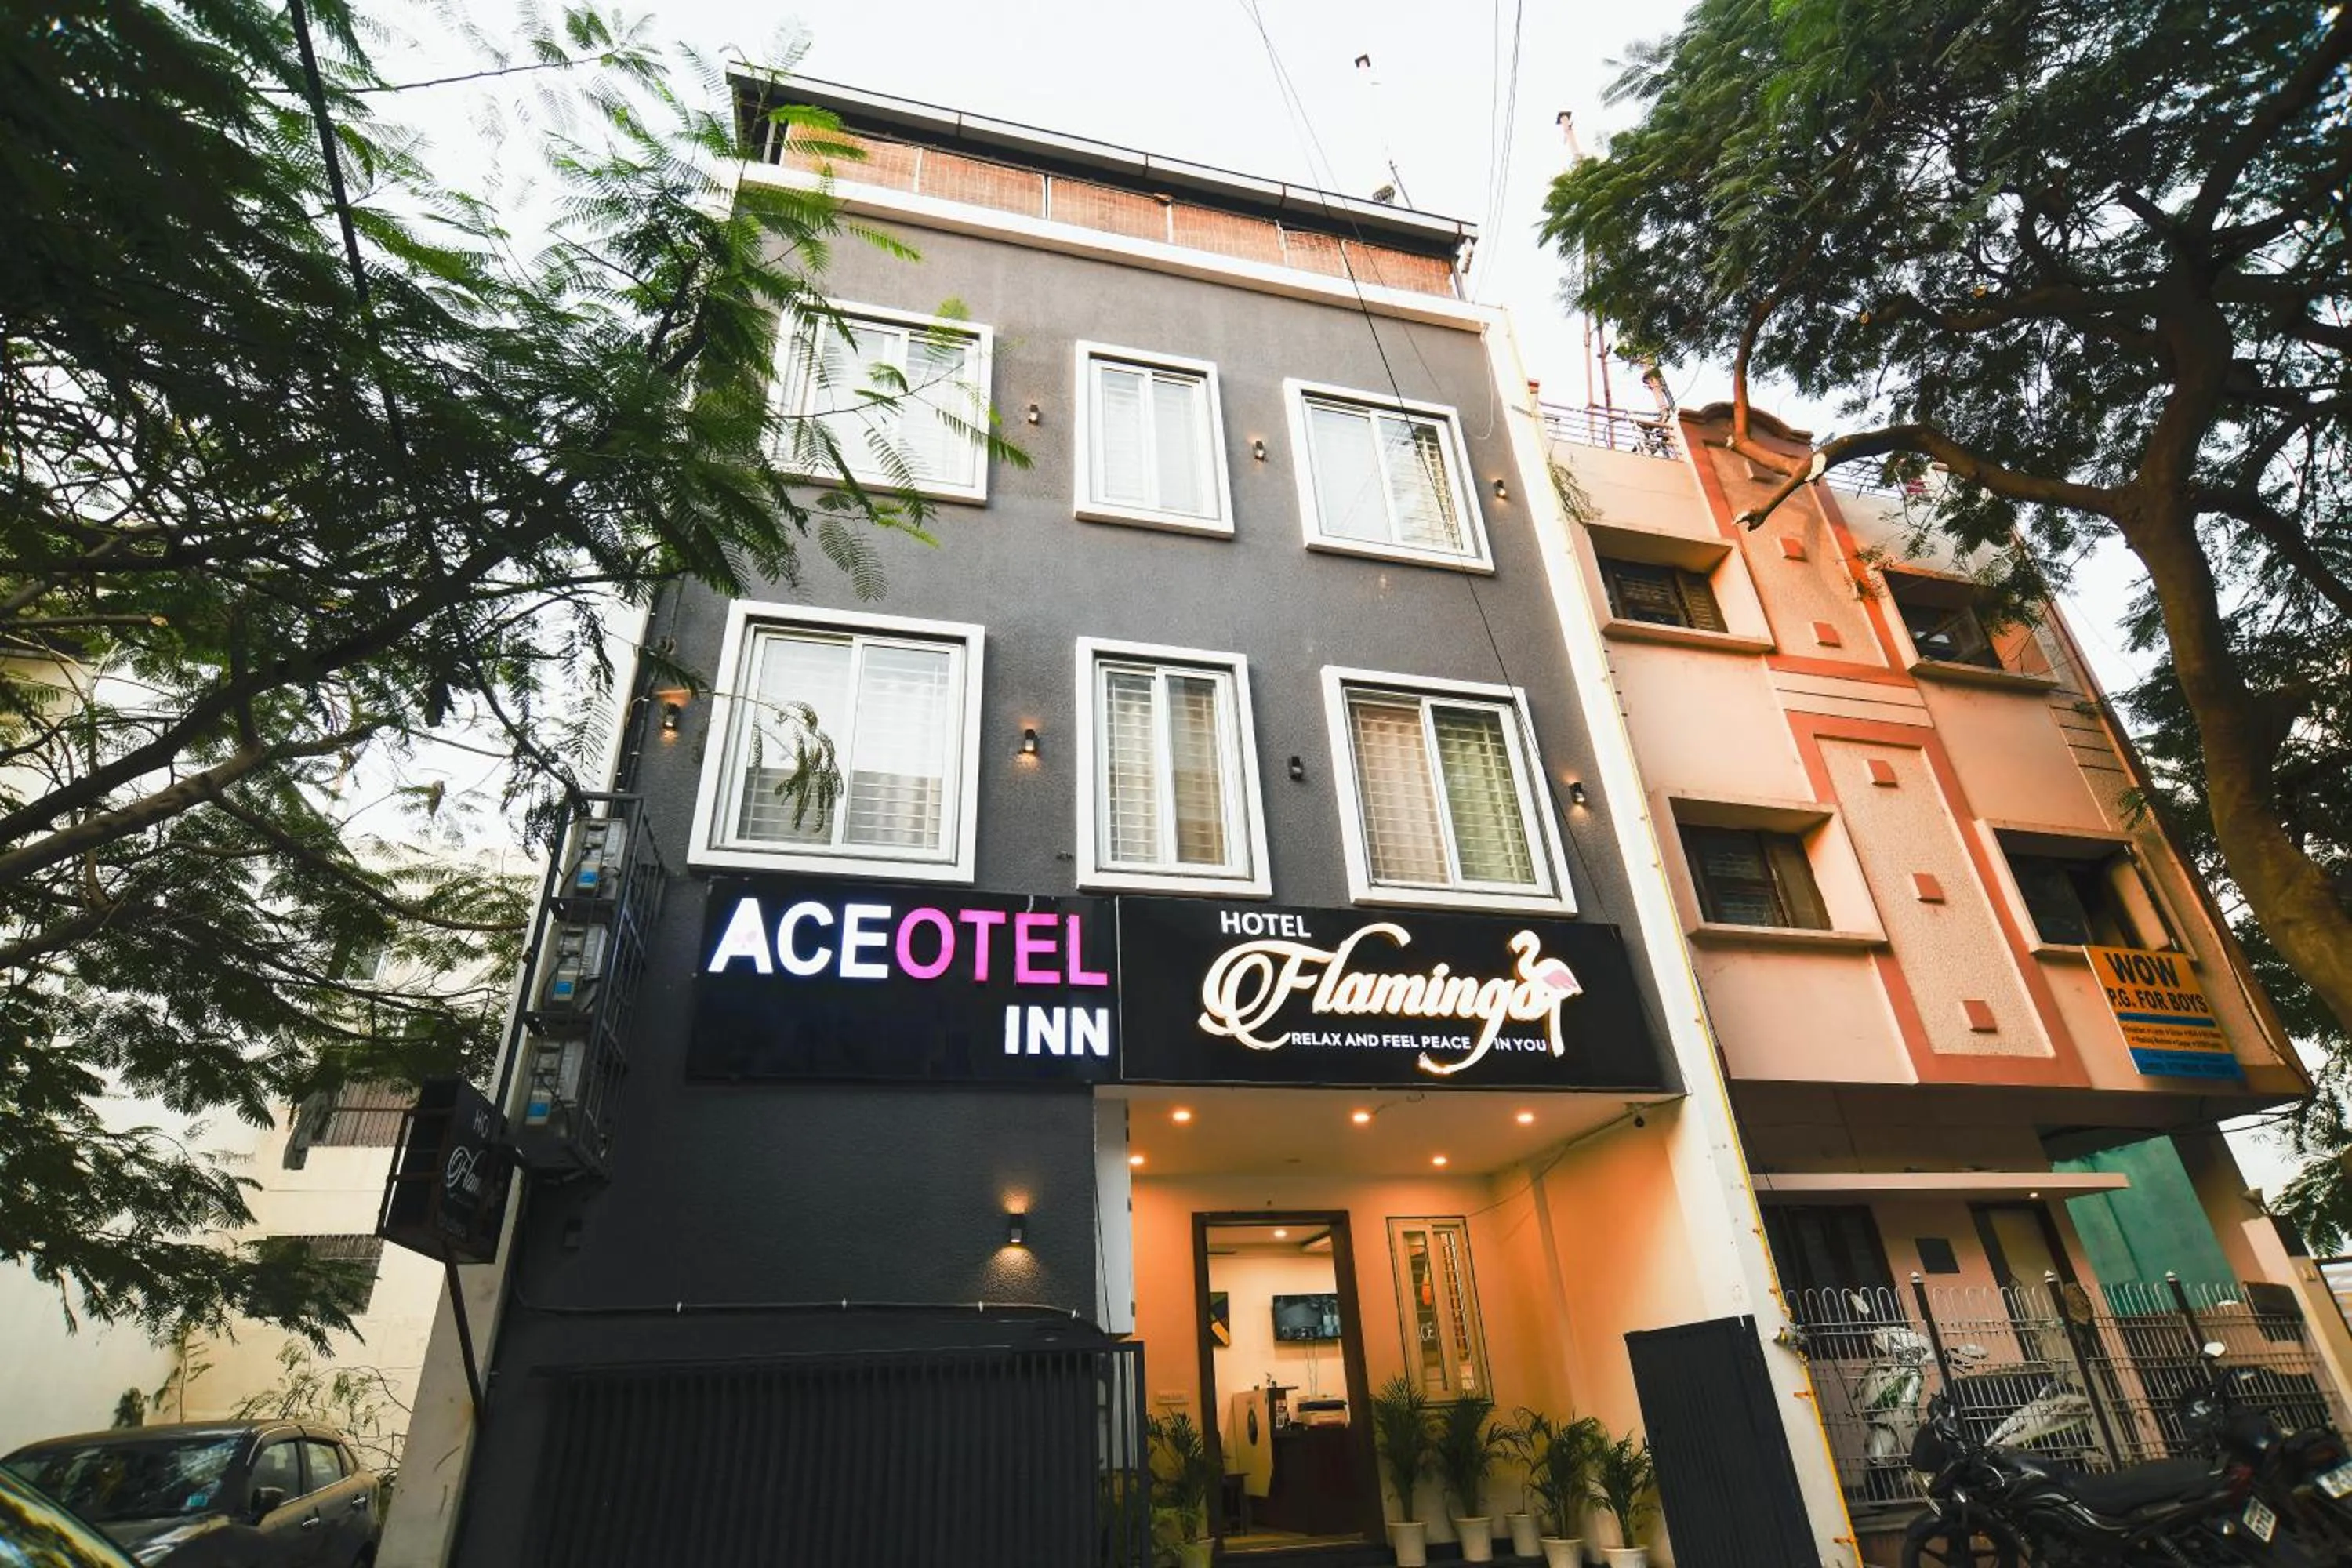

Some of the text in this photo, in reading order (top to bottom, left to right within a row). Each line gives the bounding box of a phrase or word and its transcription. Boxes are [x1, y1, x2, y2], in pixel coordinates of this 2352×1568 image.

[707, 897, 1109, 986] ACEOTEL
[1220, 910, 1312, 938] HOTEL
[2104, 953, 2180, 988] WOW
[1198, 923, 1568, 1075] Flamingo
[2135, 989, 2169, 1010] FOR
[2166, 991, 2209, 1013] BOYS
[1004, 1006, 1109, 1056] INN
[1291, 1032, 1547, 1051] RELAX AND FEEL PEACE IN YOU
